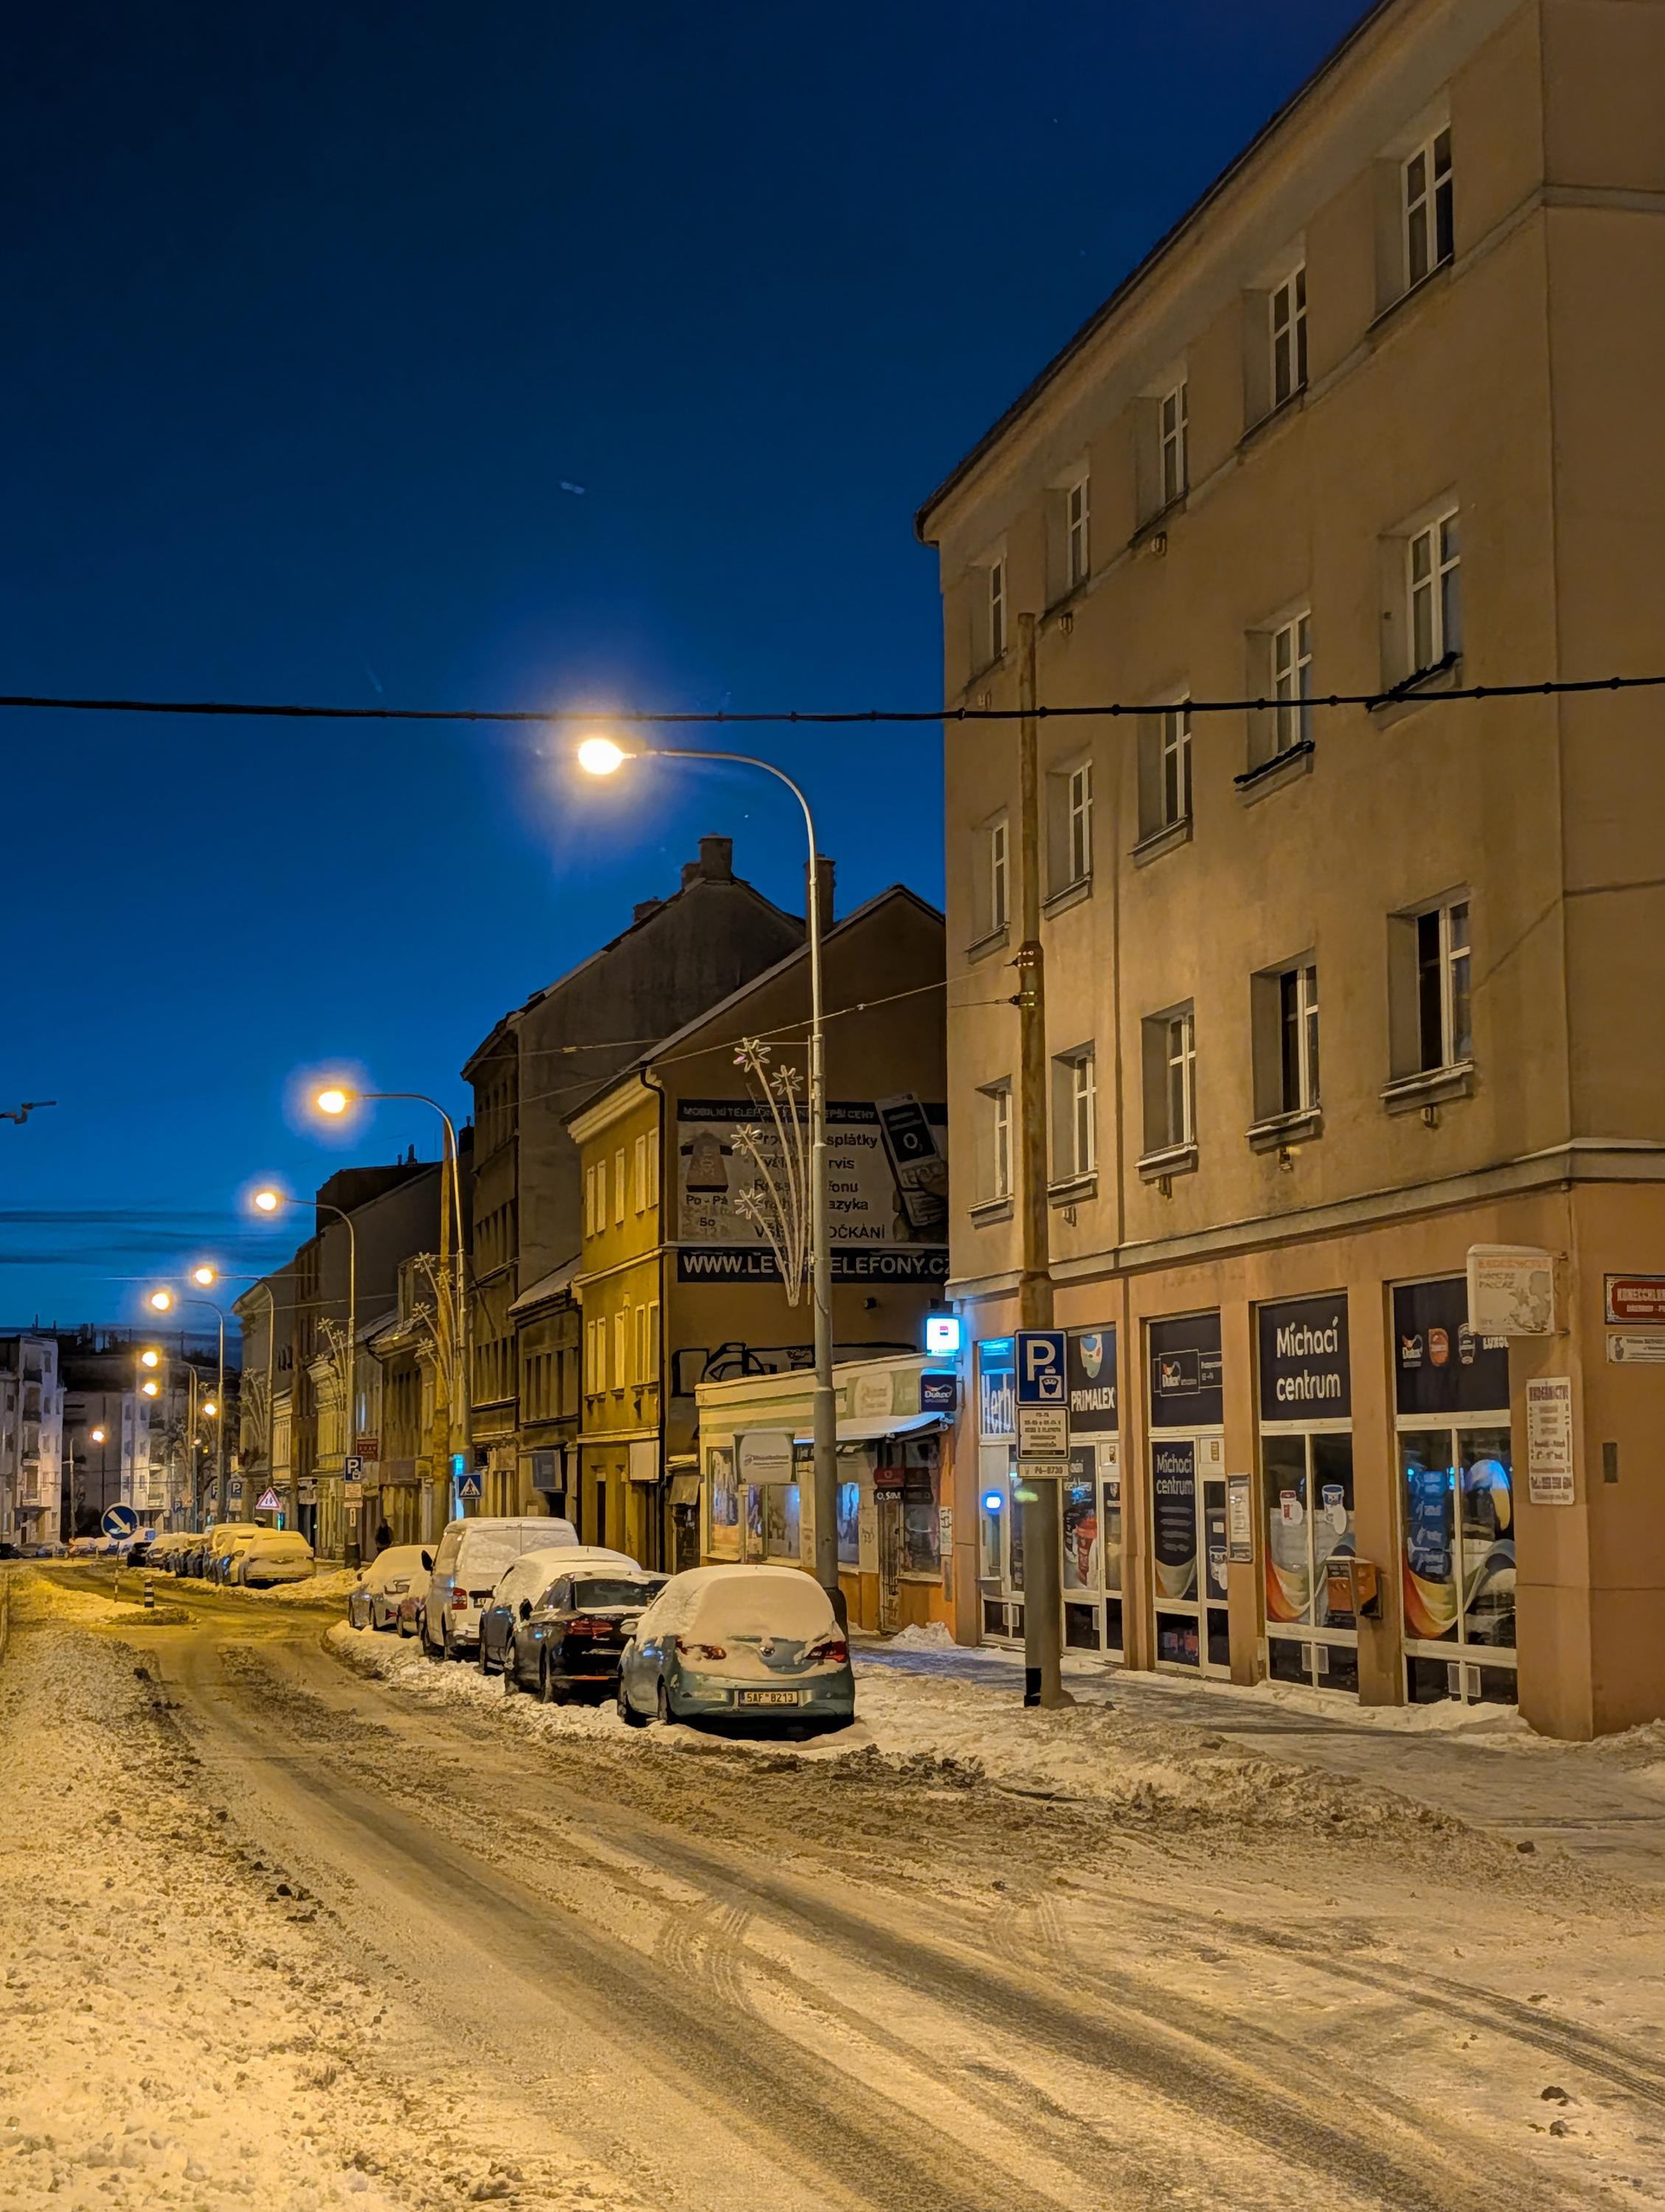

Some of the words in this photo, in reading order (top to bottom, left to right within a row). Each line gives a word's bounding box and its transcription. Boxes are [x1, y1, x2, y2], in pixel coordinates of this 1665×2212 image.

[1026, 1340, 1056, 1381] P
[1276, 1369, 1341, 1402] centrum
[1071, 1387, 1116, 1412] PRIMALEX
[347, 1459, 359, 1474] P
[232, 1483, 241, 1492] P
[1156, 1475, 1194, 1495] centrum
